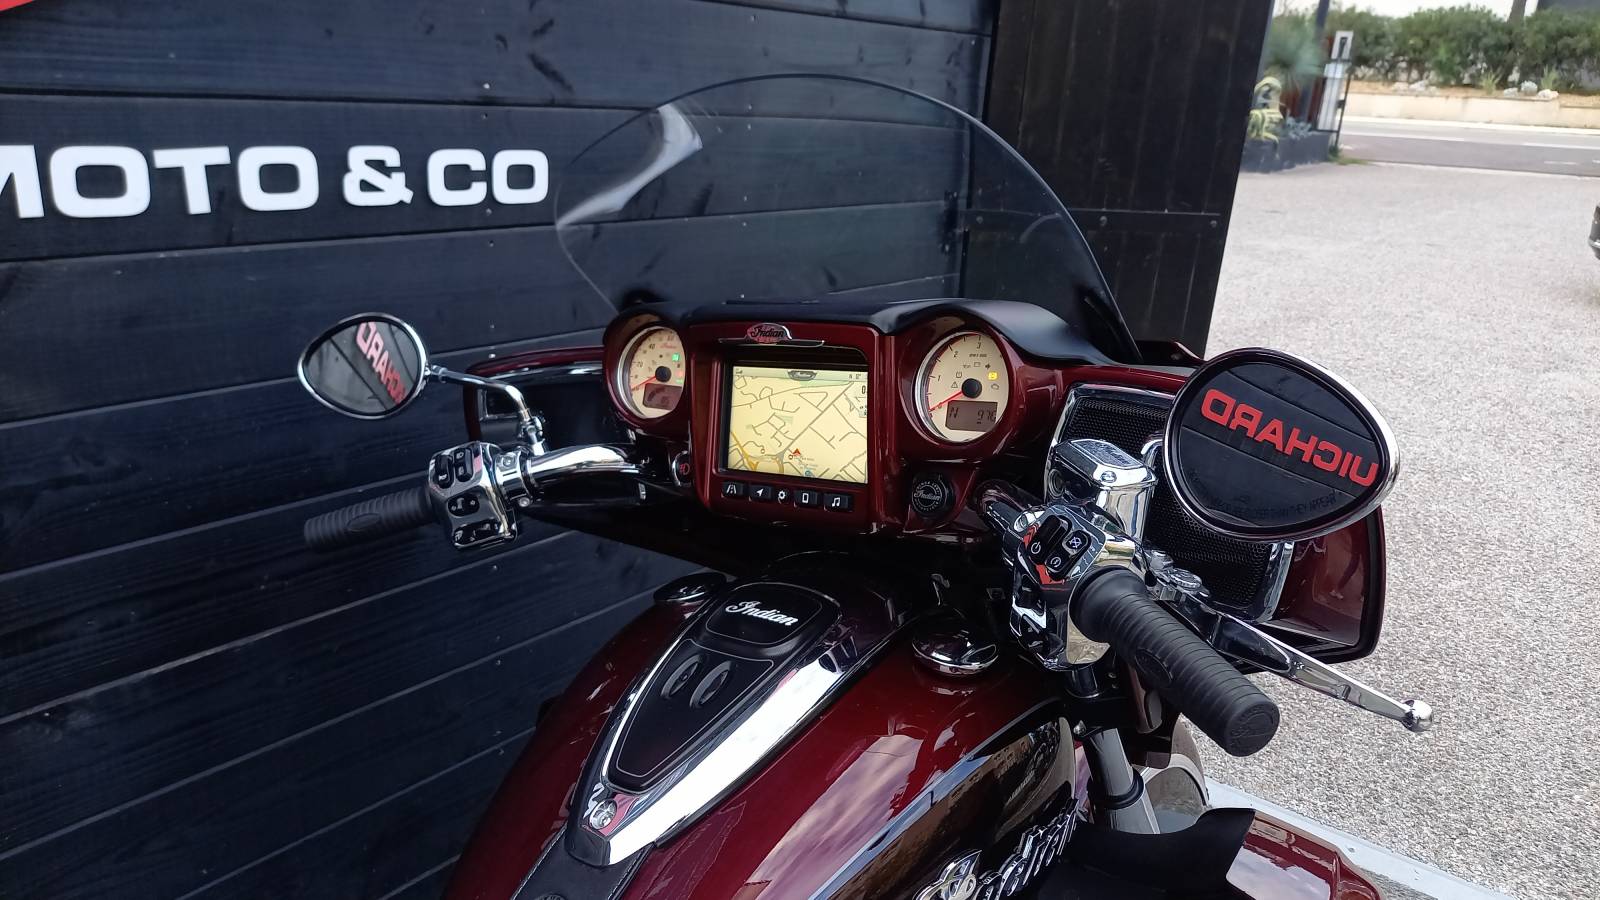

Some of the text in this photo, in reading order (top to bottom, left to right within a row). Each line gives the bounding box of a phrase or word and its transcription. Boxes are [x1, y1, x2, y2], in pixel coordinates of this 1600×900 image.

[343, 145, 413, 206] &
[427, 149, 549, 206] CO
[725, 601, 798, 626] Indian
